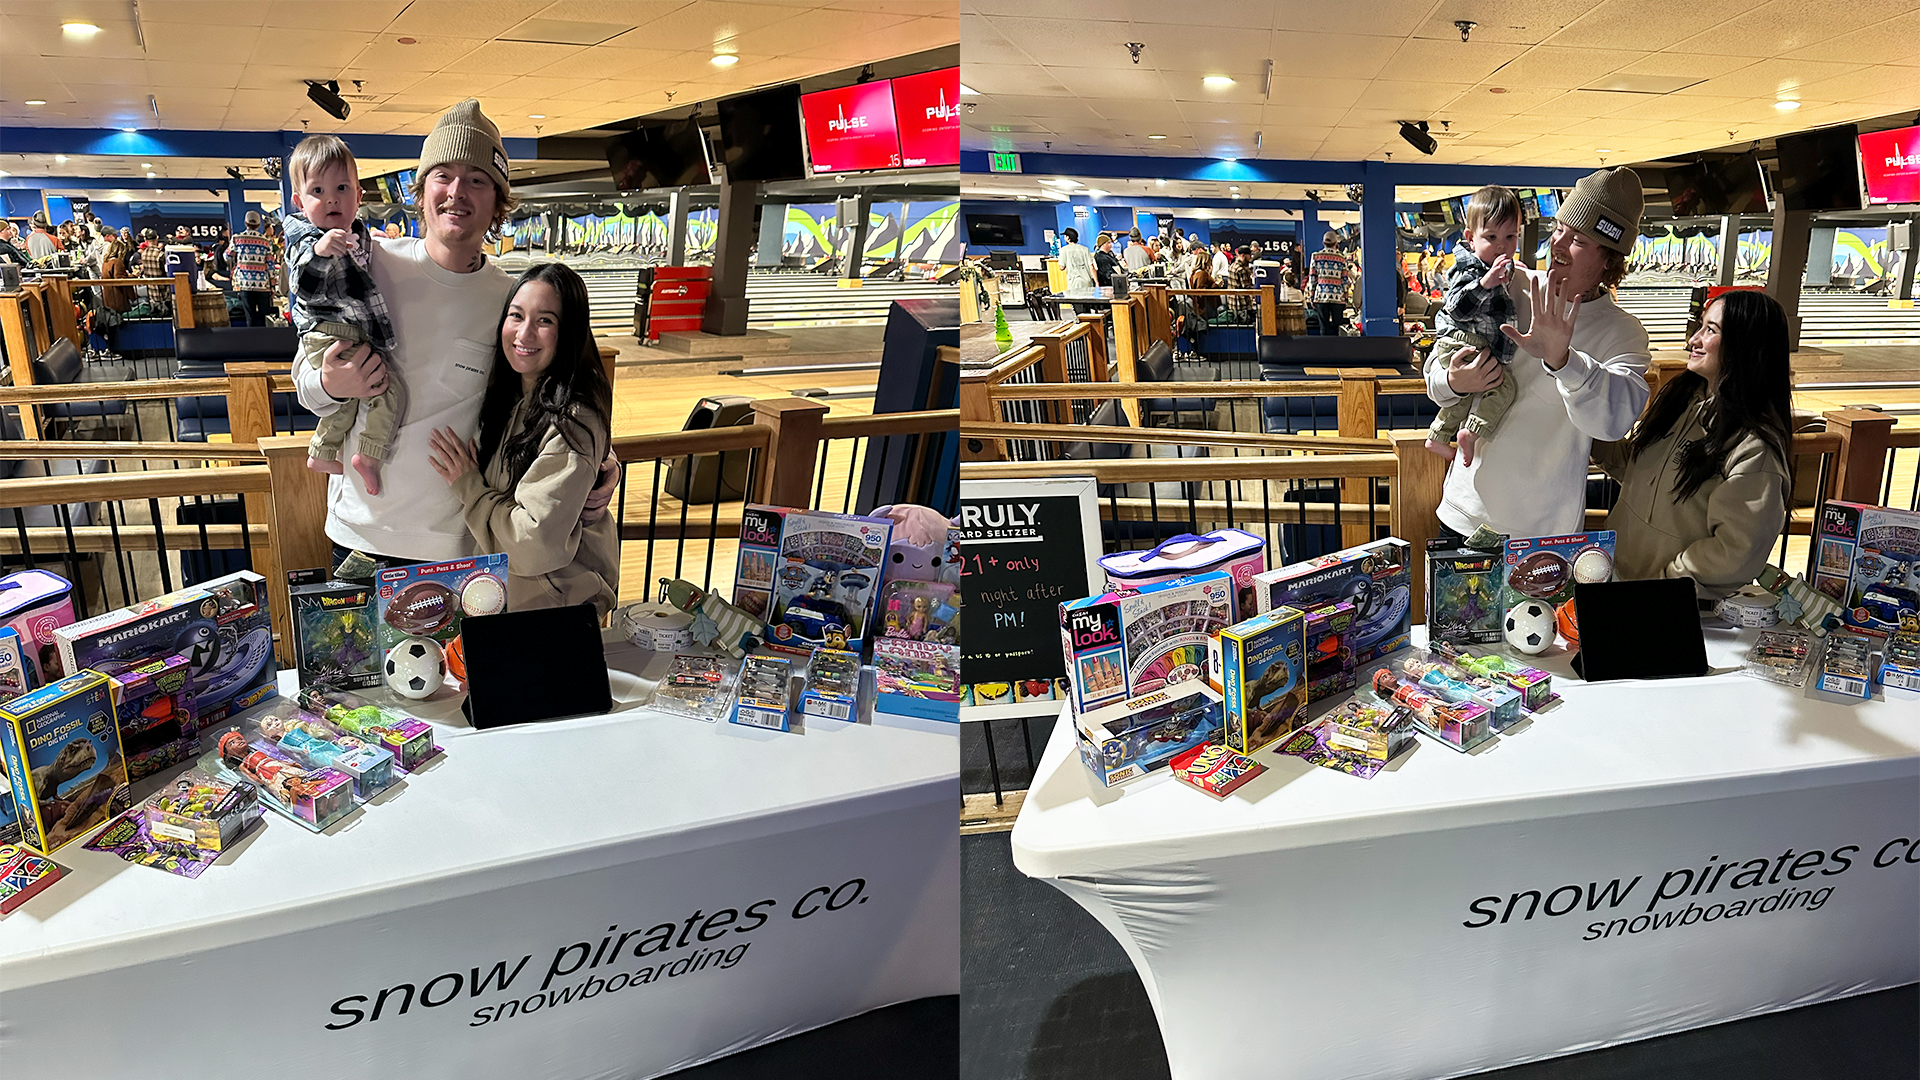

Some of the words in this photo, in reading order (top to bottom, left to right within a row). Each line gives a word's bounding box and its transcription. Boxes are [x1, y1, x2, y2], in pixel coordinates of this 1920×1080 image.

[828, 104, 868, 133] PULSE
[994, 153, 1016, 171] EXIT
[1596, 219, 1622, 240] SLUSH
[745, 516, 768, 533] my
[1825, 510, 1847, 525] my
[743, 527, 777, 545] look
[987, 528, 1036, 538] SELTZER
[1823, 518, 1854, 537] look
[865, 534, 882, 543] 950
[1006, 556, 1040, 572] only
[1288, 565, 1354, 592] MARIOKART
[321, 596, 346, 607] DRAGON
[980, 586, 1019, 609] night
[1026, 582, 1064, 600] after
[1210, 591, 1226, 600] 950
[98, 610, 190, 648] MARIOKART
[994, 611, 1025, 629] PM!
[1073, 613, 1102, 631] my
[885, 626, 910, 639] Barbie
[1074, 624, 1117, 646] look
[876, 644, 935, 661] LAND
[877, 637, 952, 654] CANDY
[1247, 652, 1263, 665] DINO
[1263, 643, 1284, 658] FOSSIL
[86, 690, 106, 706] STEM
[1126, 692, 1166, 707] SONIC
[36, 710, 60, 724] NATIONAL
[36, 711, 67, 729] GEOGRAPHIC
[30, 732, 53, 749] DINO
[53, 718, 83, 738] FOSSIL
[48, 737, 60, 747] DIG
[59, 732, 69, 742] KIT
[1187, 745, 1228, 774] UNO
[1109, 767, 1134, 780] SONIC
[31, 861, 49, 875] WILD
[1462, 875, 1643, 929] snow
[1645, 844, 1861, 912] pirates
[1582, 885, 1837, 942] snowboarding
[324, 954, 533, 1031] snow
[539, 899, 777, 991] pirates
[791, 877, 871, 920] co.
[468, 940, 752, 1028] snowboarding
